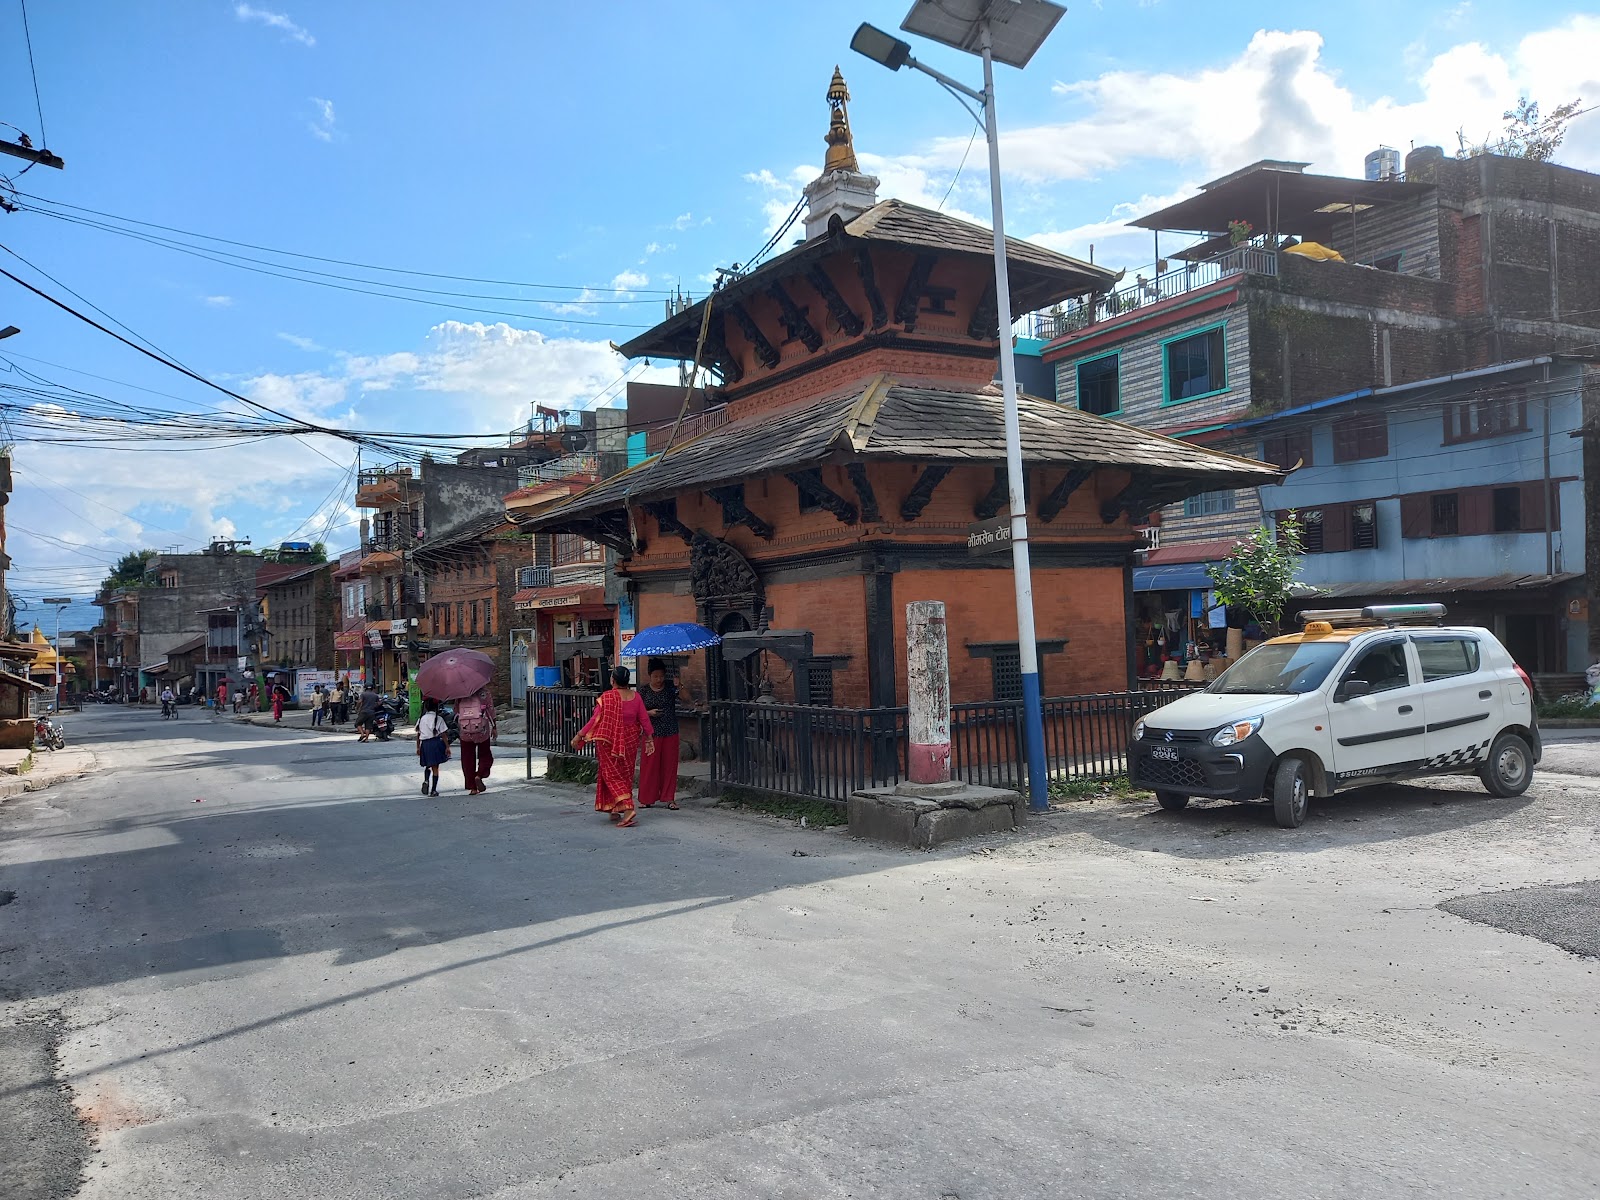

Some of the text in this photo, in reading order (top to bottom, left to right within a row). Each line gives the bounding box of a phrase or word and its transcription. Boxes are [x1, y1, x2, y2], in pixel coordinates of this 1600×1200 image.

[967, 525, 1011, 548] भीमसेन टोल
[1345, 768, 1378, 778] SUZUKI
